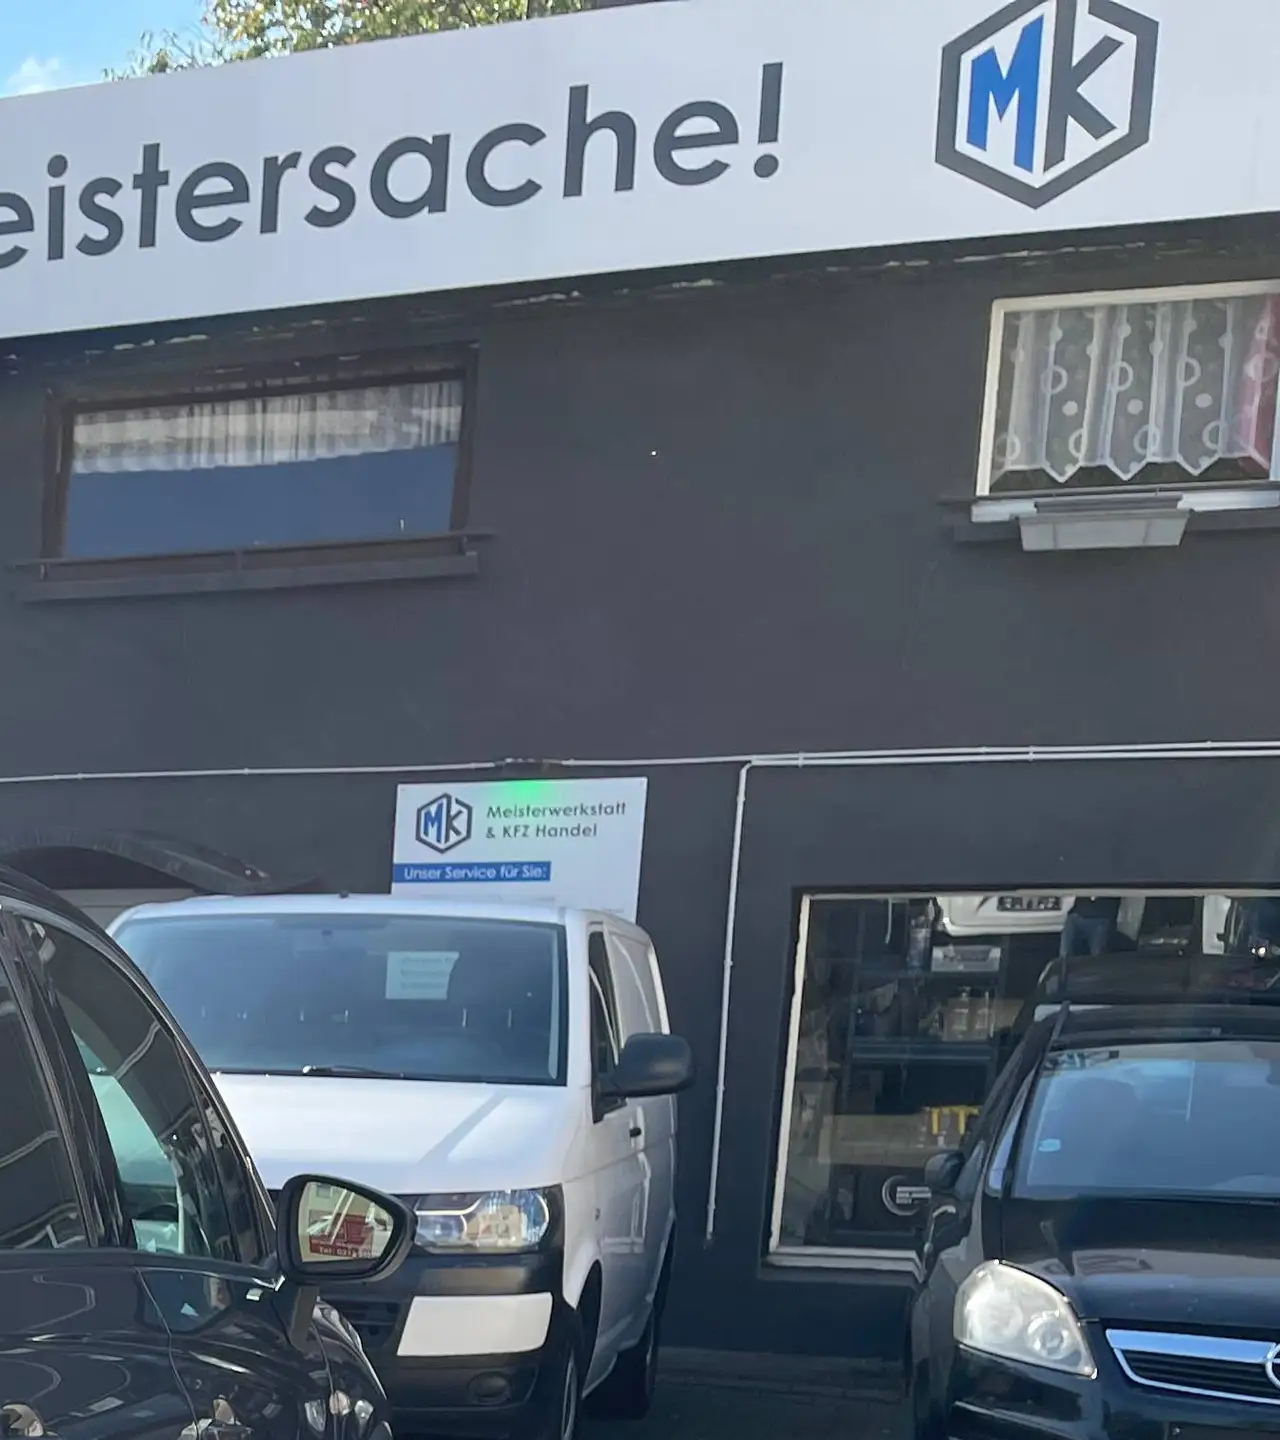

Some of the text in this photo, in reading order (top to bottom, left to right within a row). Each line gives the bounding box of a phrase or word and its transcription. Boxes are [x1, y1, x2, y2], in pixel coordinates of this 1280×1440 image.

[966, 0, 1125, 174] MK
[487, 802, 627, 819] Meisterwerkstatt
[423, 797, 464, 844] MK
[485, 823, 598, 839] & KFZ Handel
[404, 864, 547, 880] Unser Service für Sie:
